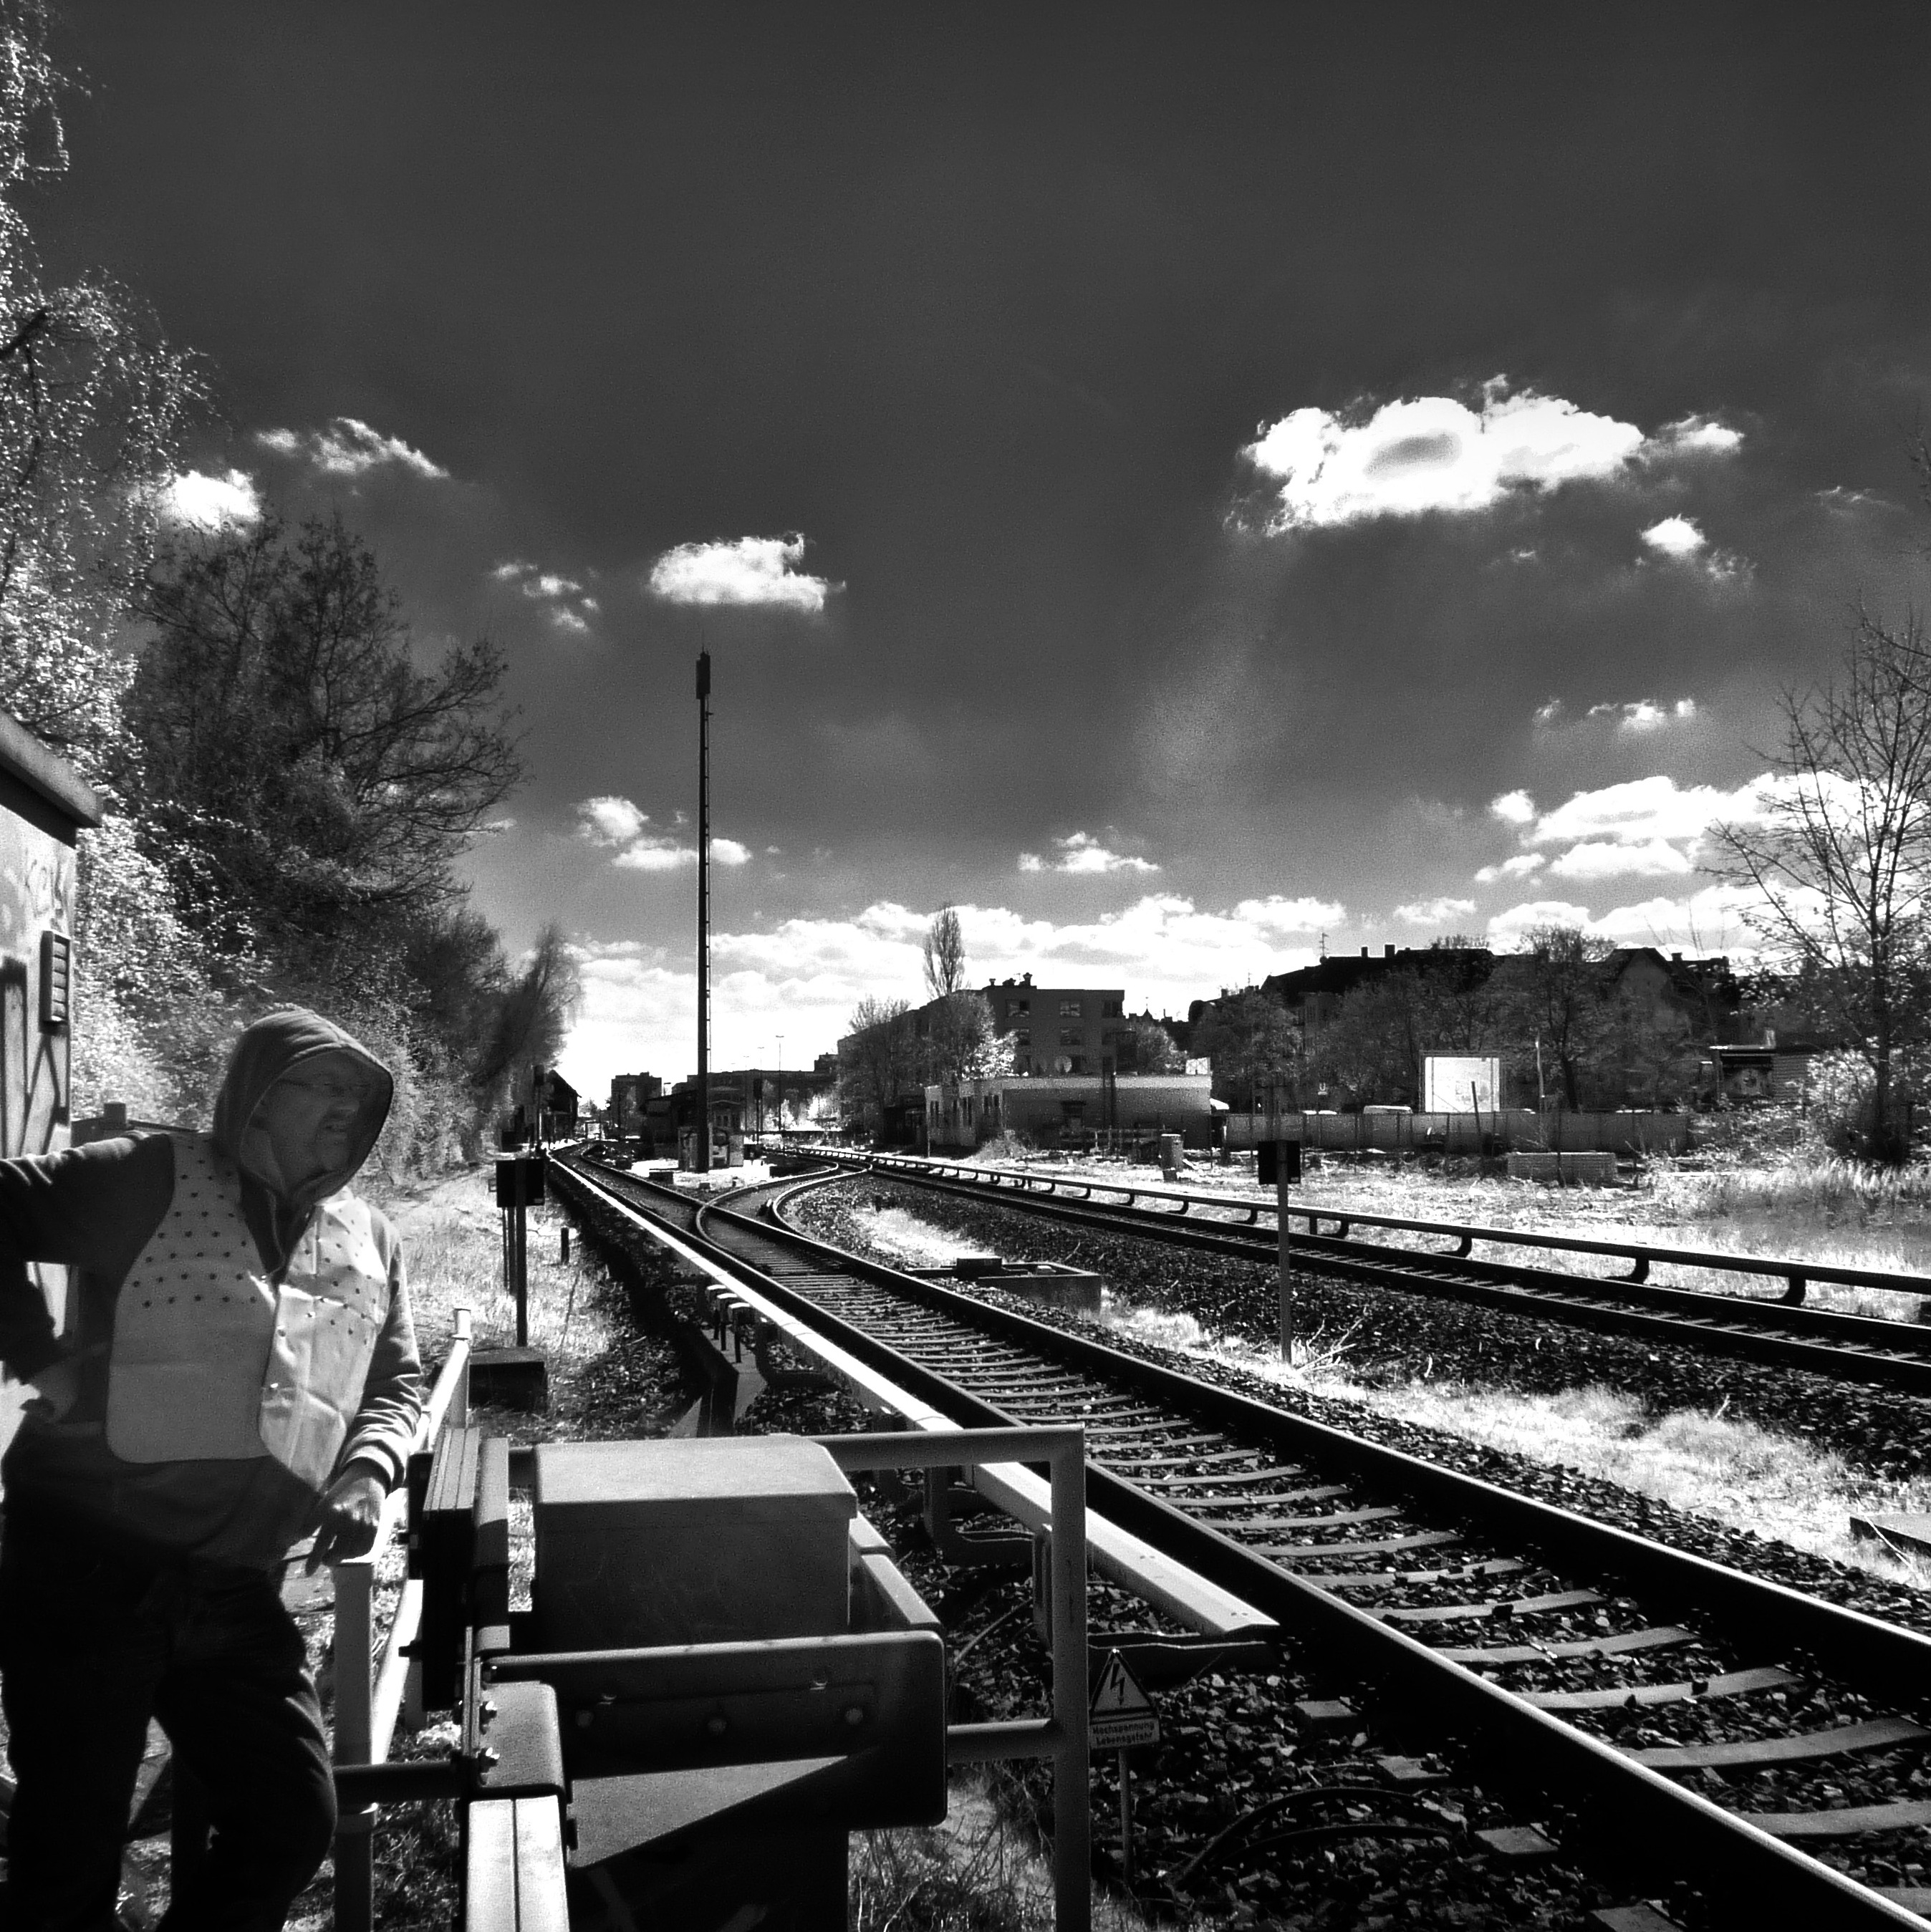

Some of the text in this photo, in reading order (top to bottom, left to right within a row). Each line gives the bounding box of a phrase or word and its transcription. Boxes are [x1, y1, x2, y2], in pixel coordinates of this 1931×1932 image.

[1319, 1082, 1326, 1091] U
[1092, 1721, 1155, 1734] Hochspannung
[1096, 1732, 1152, 1744] Lebensgefahr
